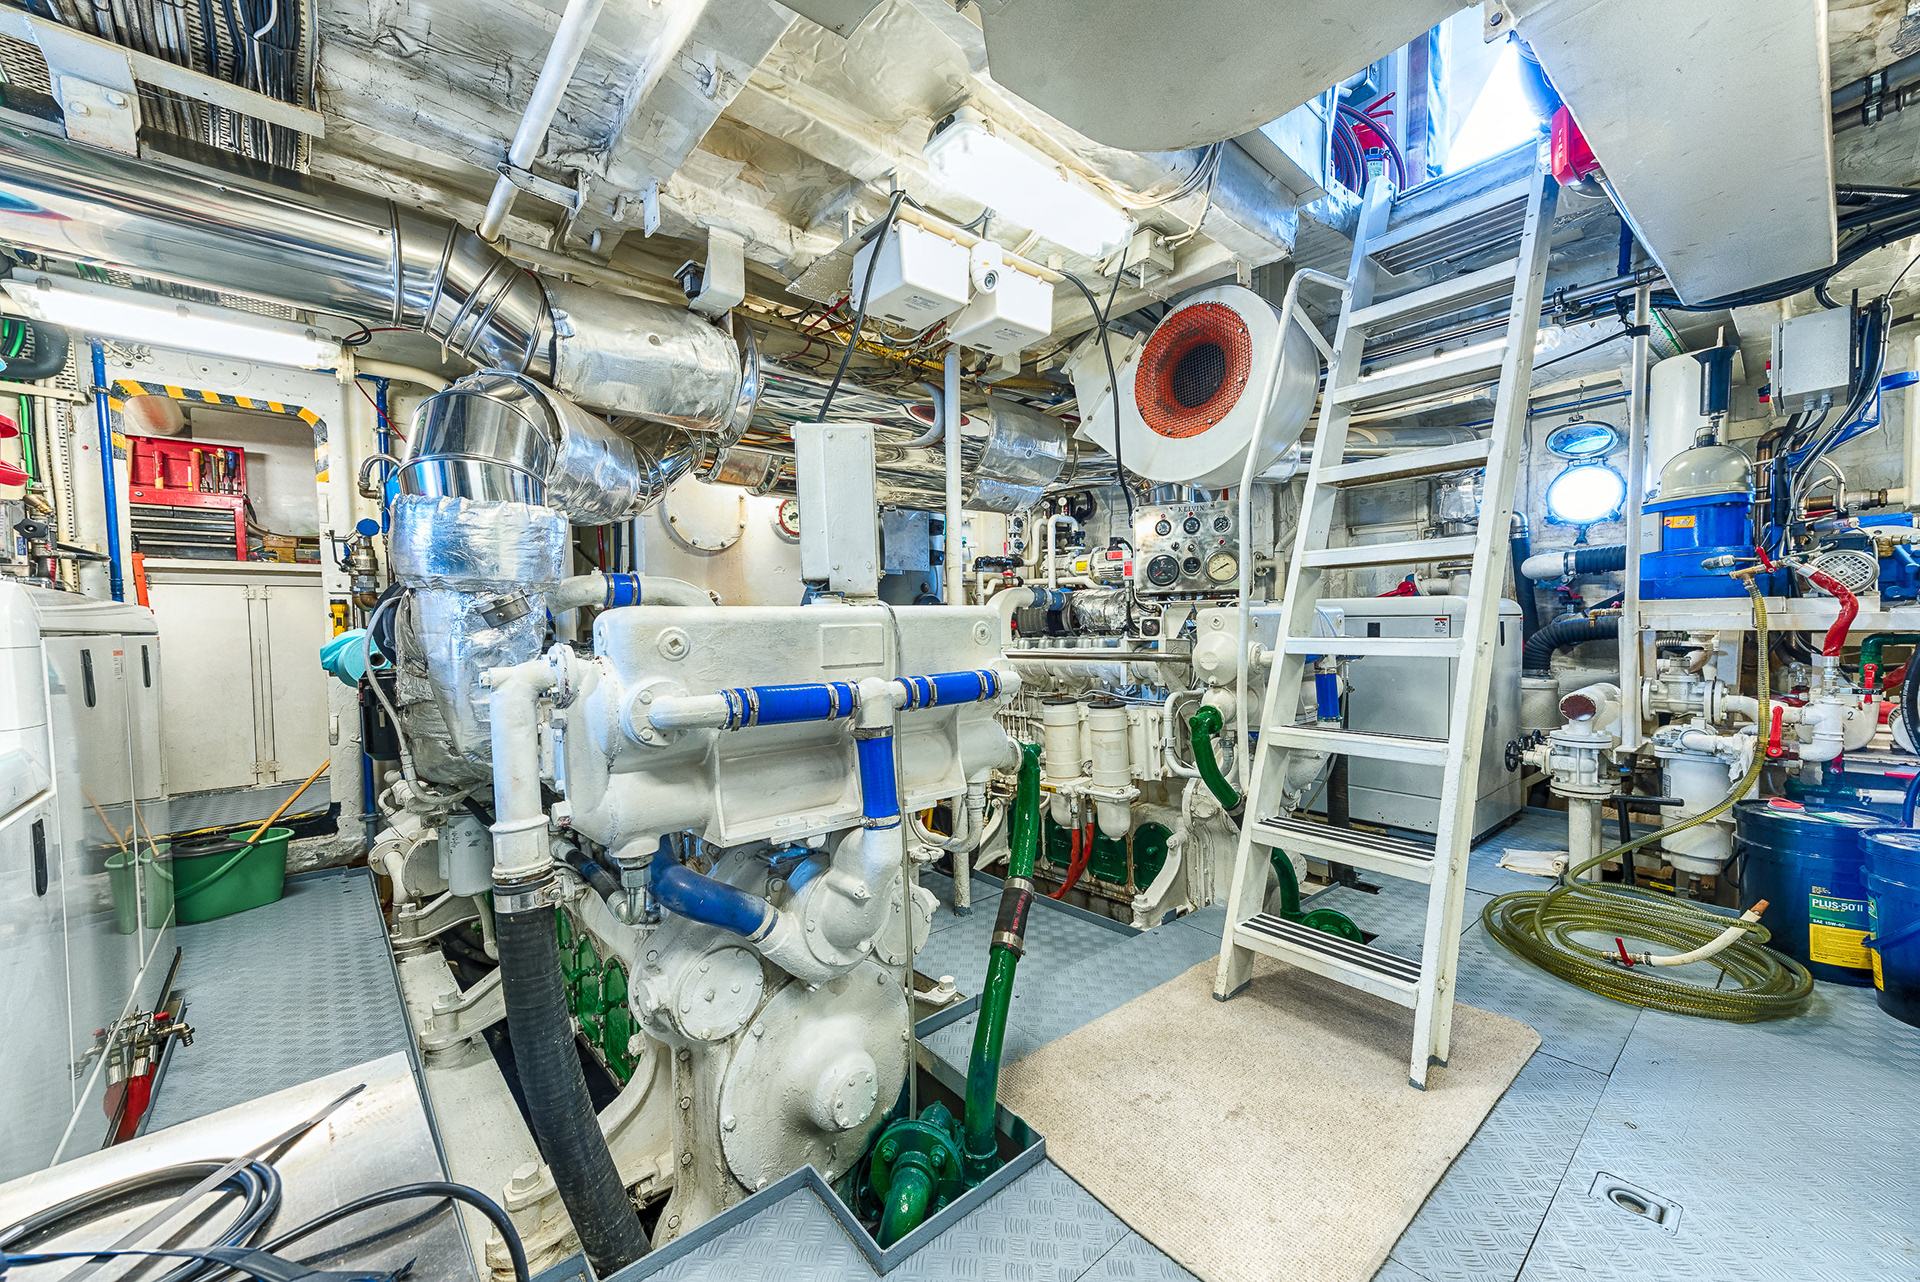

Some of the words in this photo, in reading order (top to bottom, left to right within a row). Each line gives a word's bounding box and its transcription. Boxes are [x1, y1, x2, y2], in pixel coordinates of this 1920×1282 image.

[1178, 505, 1205, 513] KELVIN
[1847, 711, 1854, 721] 2
[1016, 900, 1024, 915] MADE
